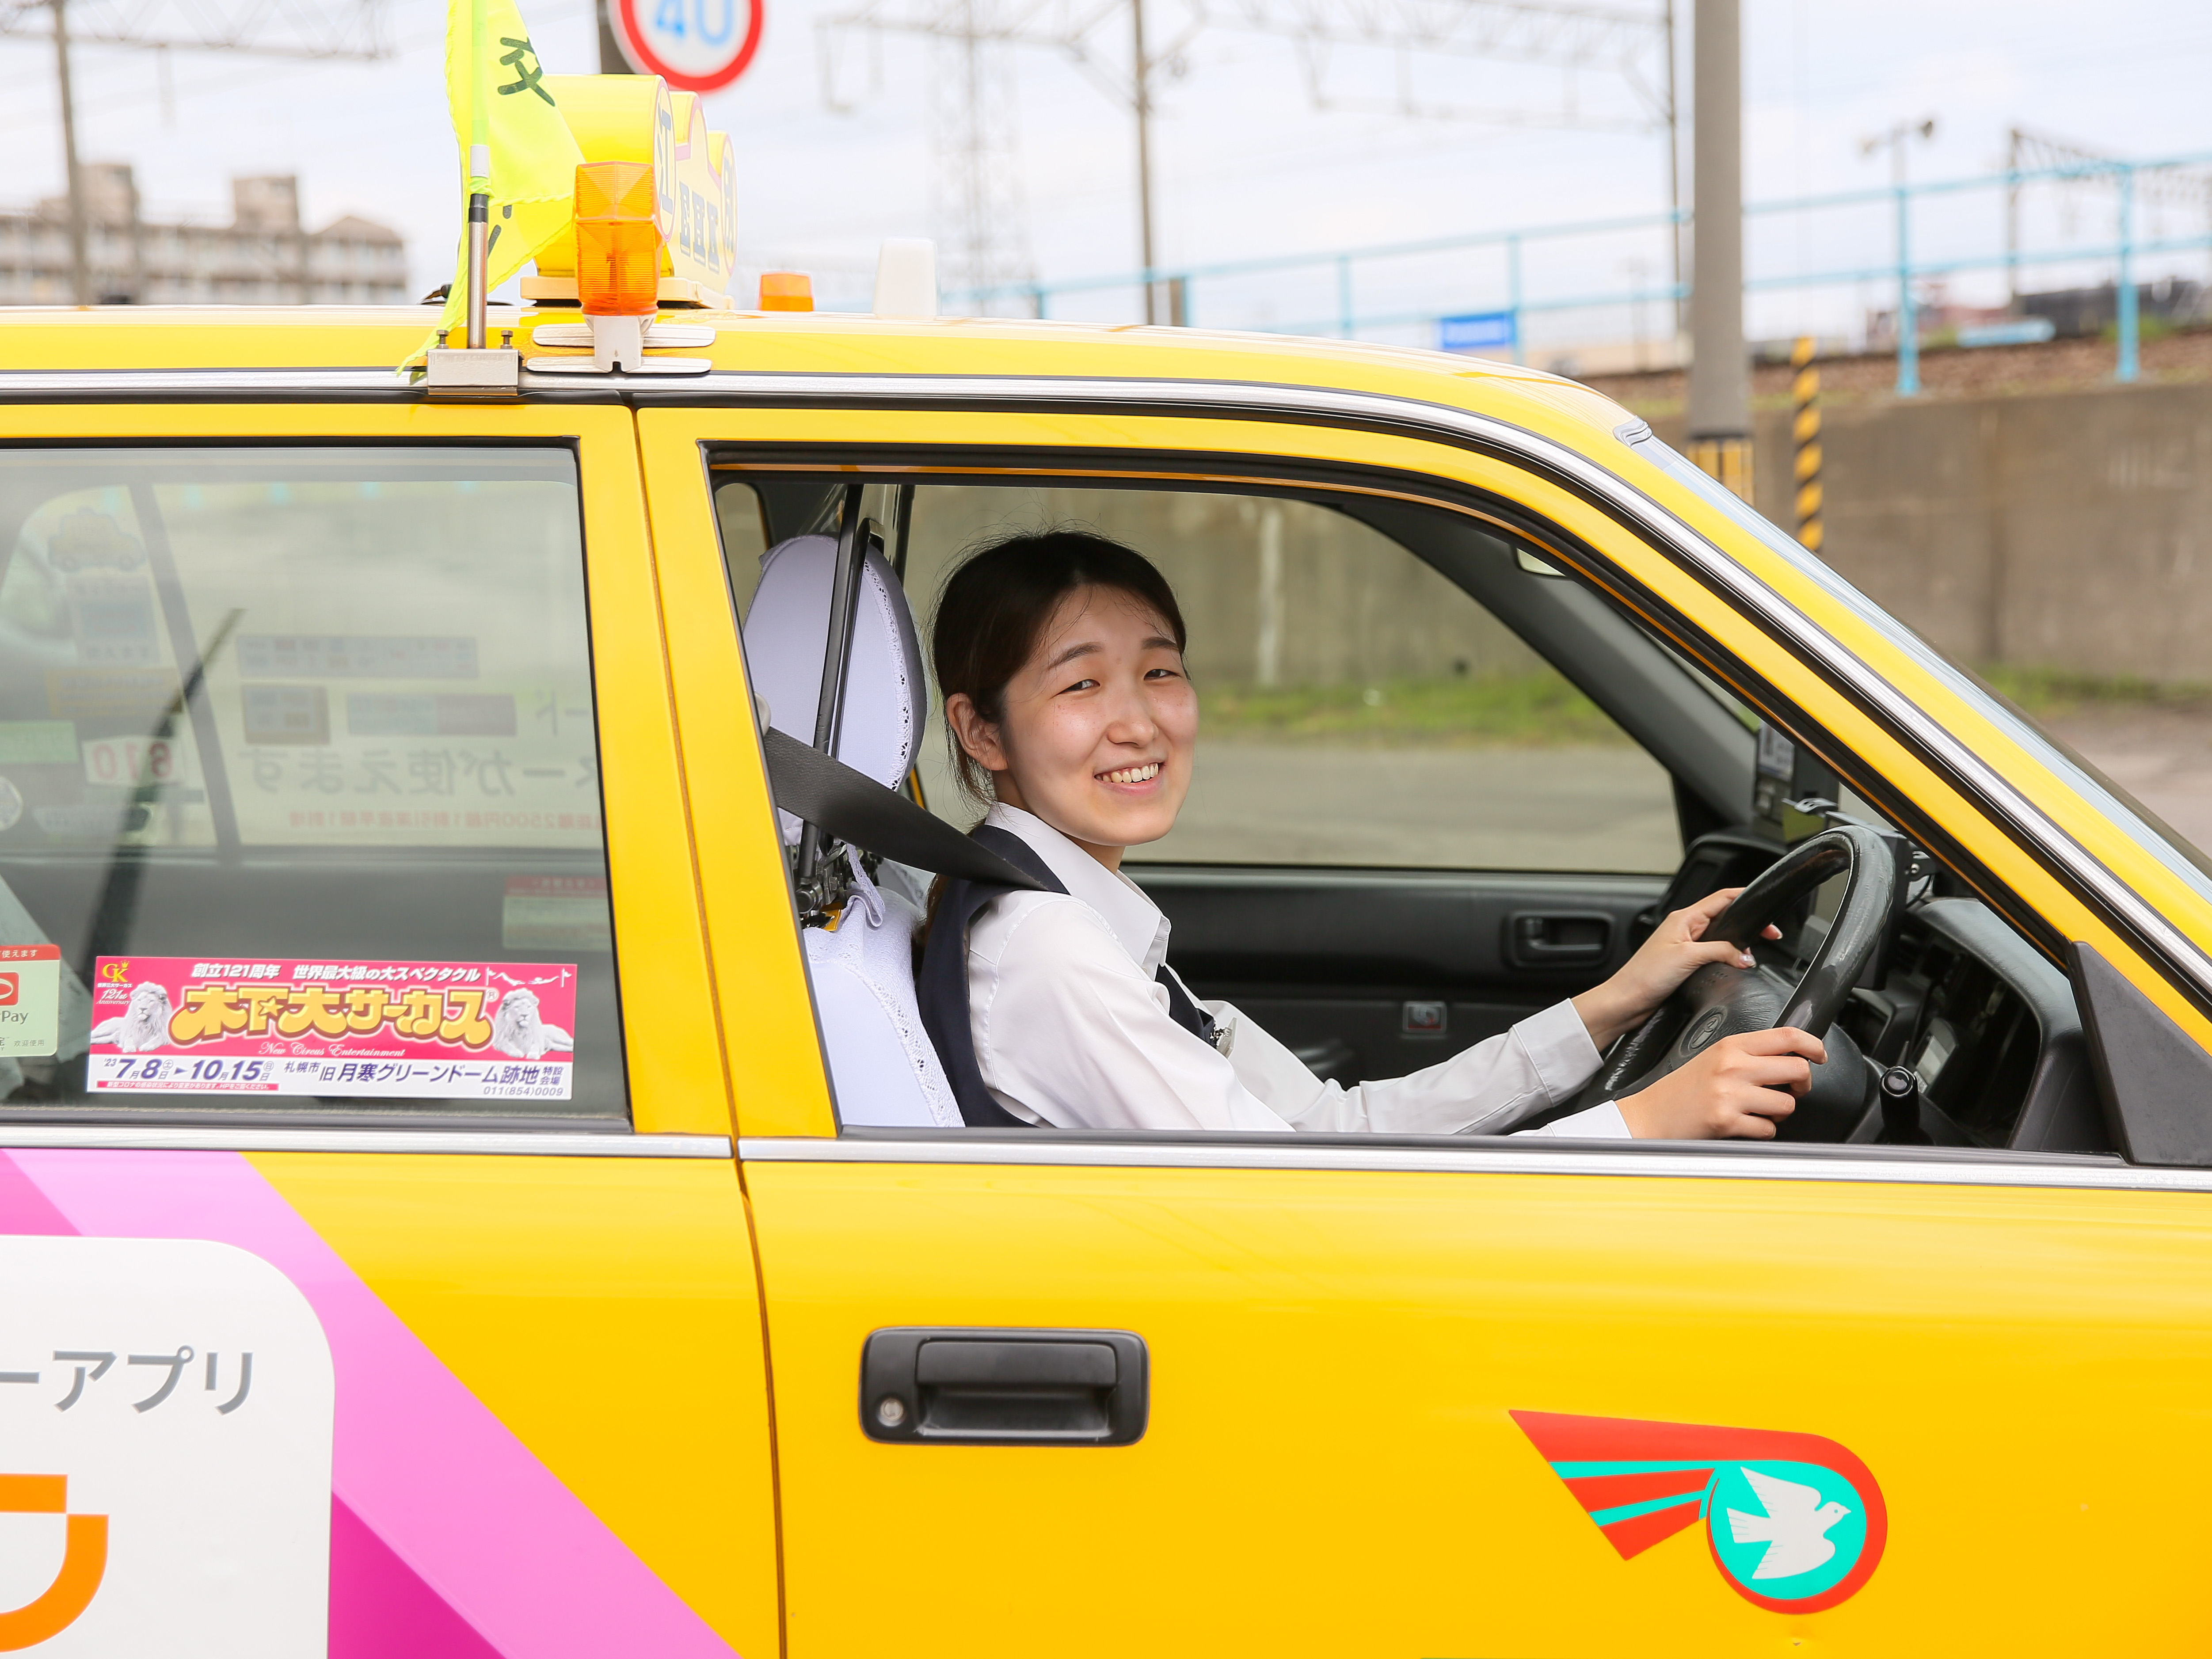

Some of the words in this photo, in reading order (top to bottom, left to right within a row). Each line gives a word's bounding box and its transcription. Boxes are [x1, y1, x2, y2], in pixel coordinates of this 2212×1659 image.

[0, 949, 38, 958] 使えます
[191, 963, 281, 979] 創立121周年
[292, 965, 482, 982] 世界最大級の大スペクタクル
[101, 989, 128, 1000] 121st
[0, 1010, 29, 1025] Pay
[170, 985, 492, 1047] 木下大サーカス
[259, 1042, 286, 1055] New
[290, 1042, 325, 1056] Circus
[328, 1044, 405, 1057] Entertainment
[483, 1085, 564, 1096] 011(854)0009
